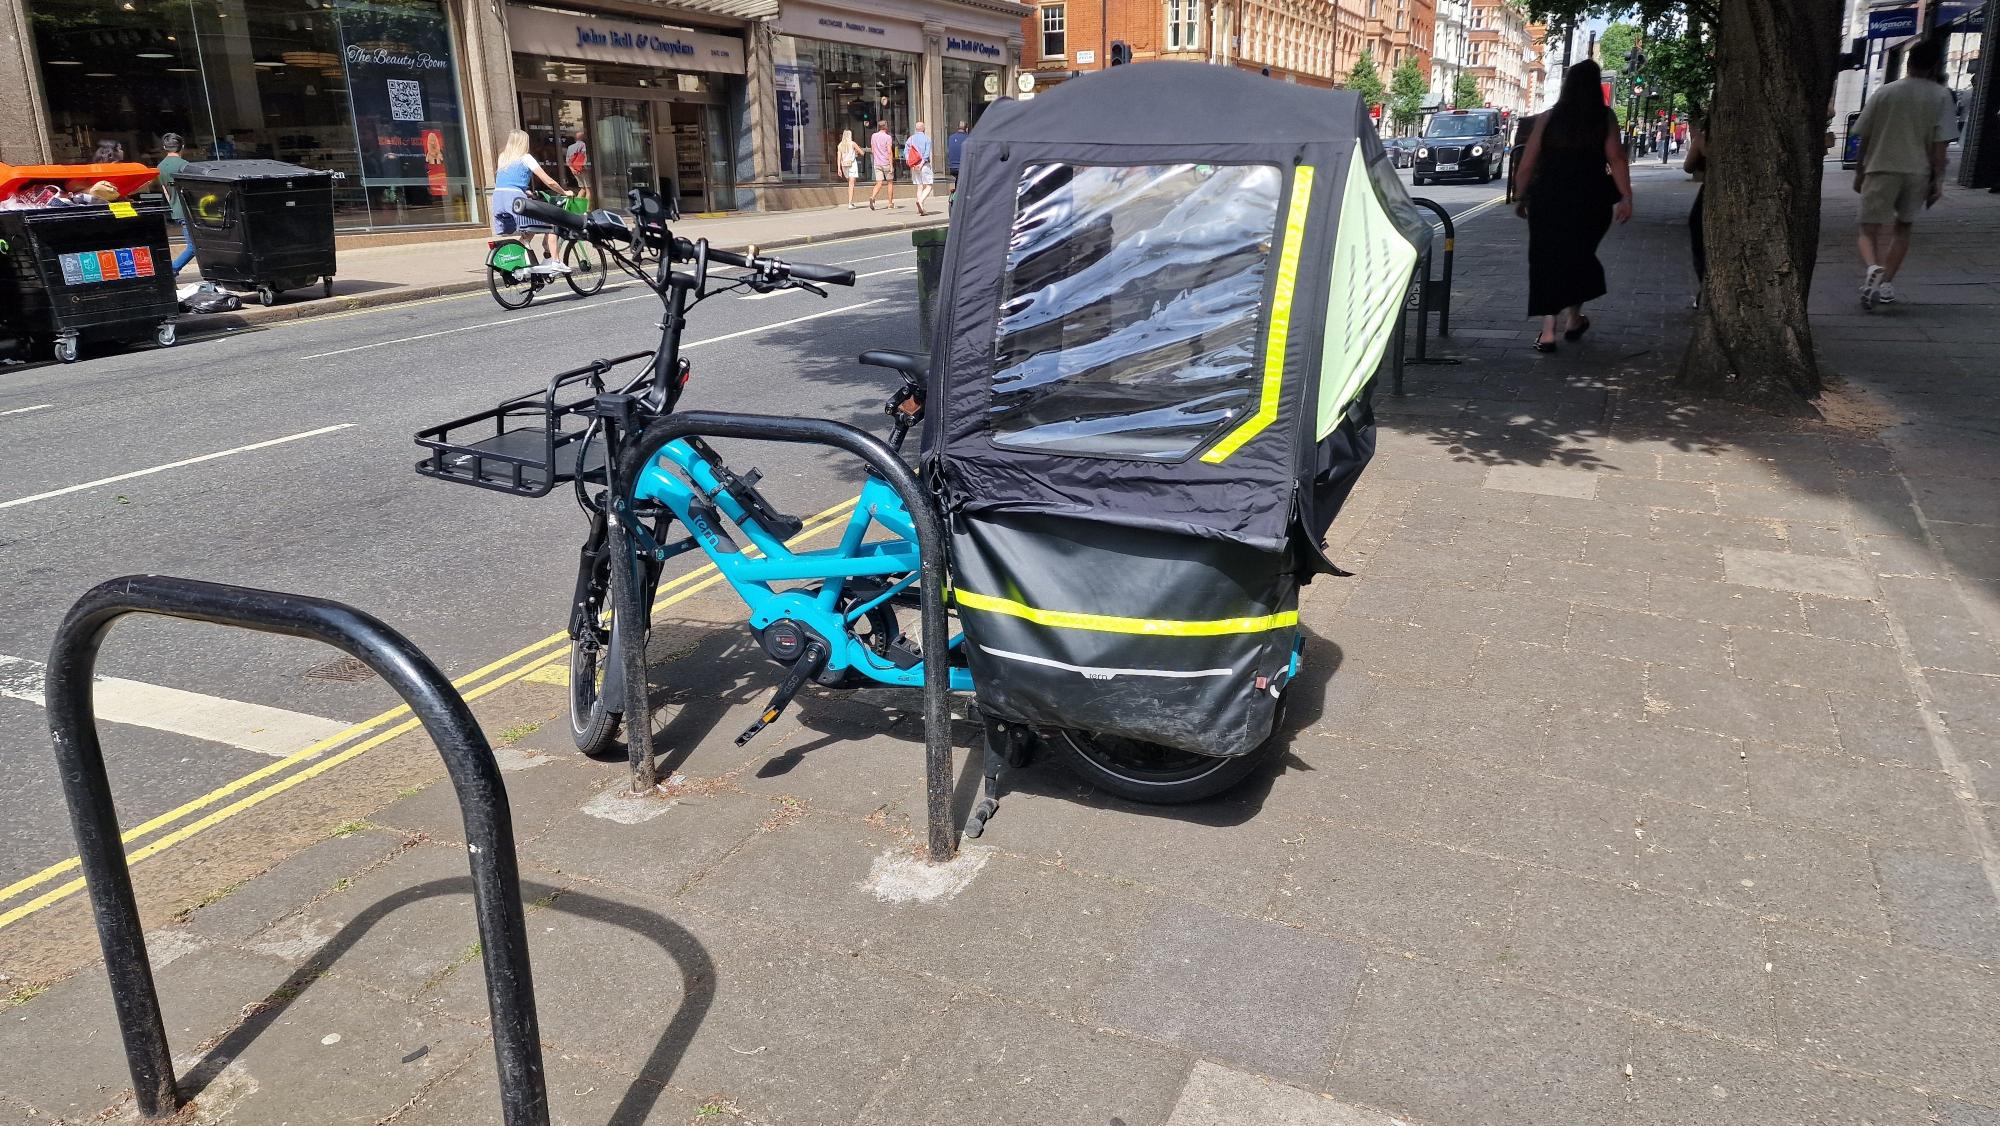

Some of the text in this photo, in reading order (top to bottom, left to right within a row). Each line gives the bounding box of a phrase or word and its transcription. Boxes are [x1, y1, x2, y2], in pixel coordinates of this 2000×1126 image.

[1870, 19, 1913, 32] Wigmore
[576, 26, 695, 57] John Bell & Croydon
[946, 37, 961, 52] John
[961, 40, 972, 51] Bell
[979, 43, 1000, 57] Croydon
[347, 45, 447, 70] The Beauty Room
[693, 514, 719, 547] tern
